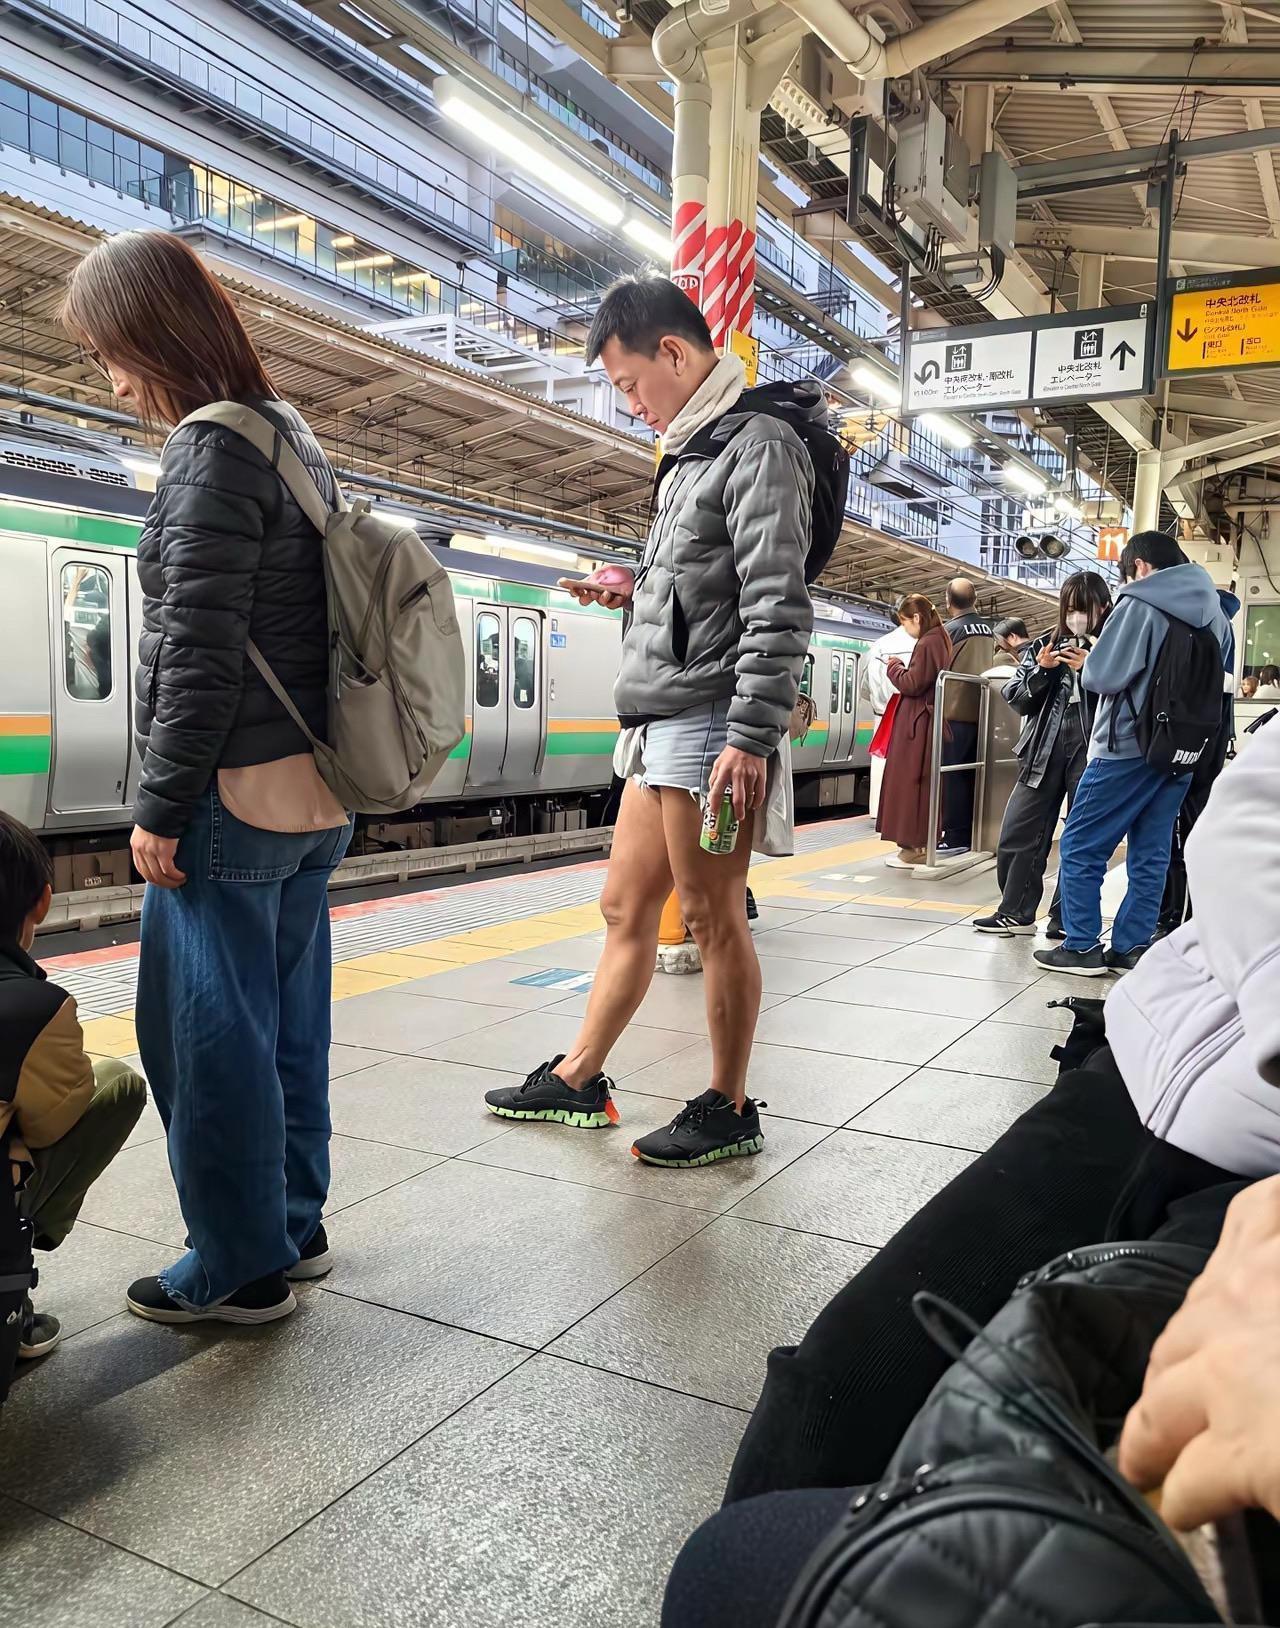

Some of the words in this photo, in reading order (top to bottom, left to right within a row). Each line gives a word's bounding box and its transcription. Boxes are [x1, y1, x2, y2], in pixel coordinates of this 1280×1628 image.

[1205, 293, 1262, 309] 中央北改札
[1058, 361, 1102, 374] 中央北改札
[1050, 372, 1102, 384] エレベーター
[944, 383, 992, 395] エレベーター
[1171, 749, 1200, 765] PUM
